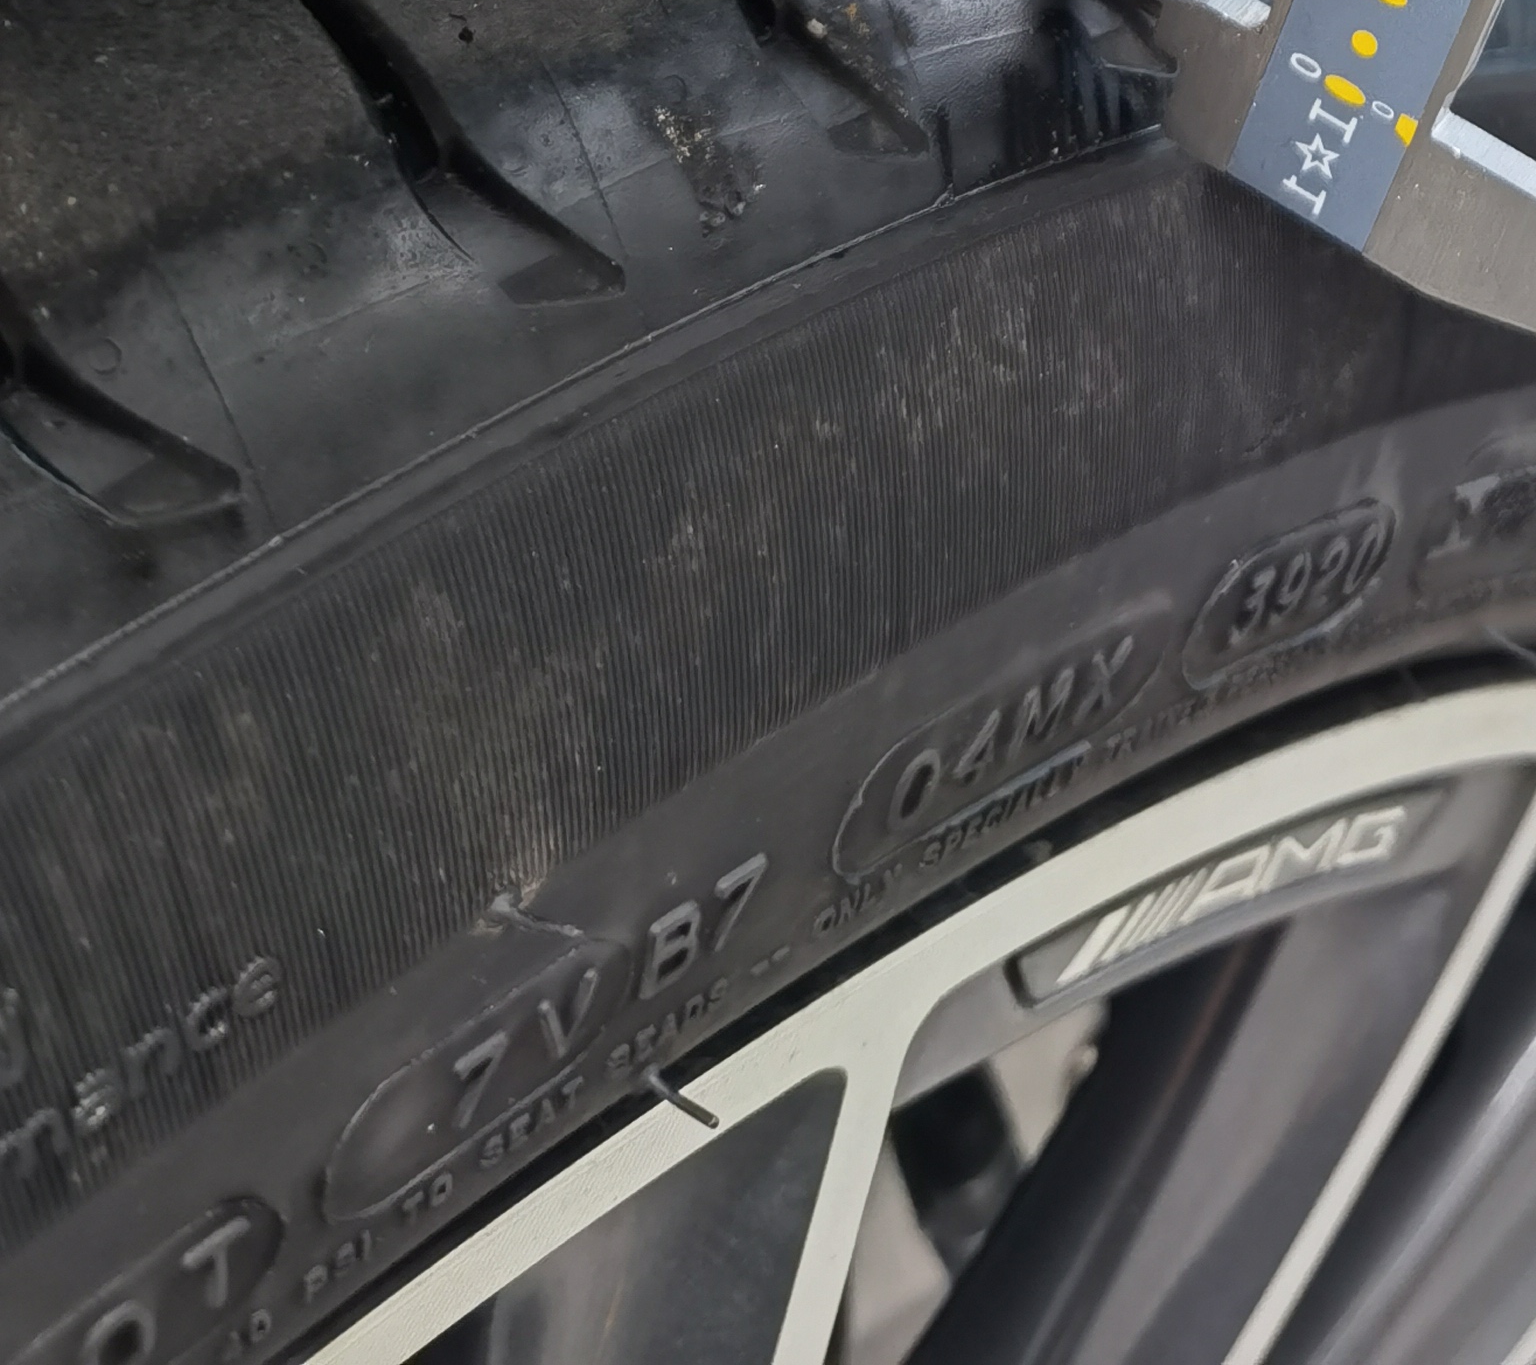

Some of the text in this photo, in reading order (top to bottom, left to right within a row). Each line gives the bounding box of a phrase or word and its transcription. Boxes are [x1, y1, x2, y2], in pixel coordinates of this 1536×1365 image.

[1290, 51, 1323, 80] 0
[1371, 100, 1395, 120] 0
[478, 1074, 586, 1167] SEAT
